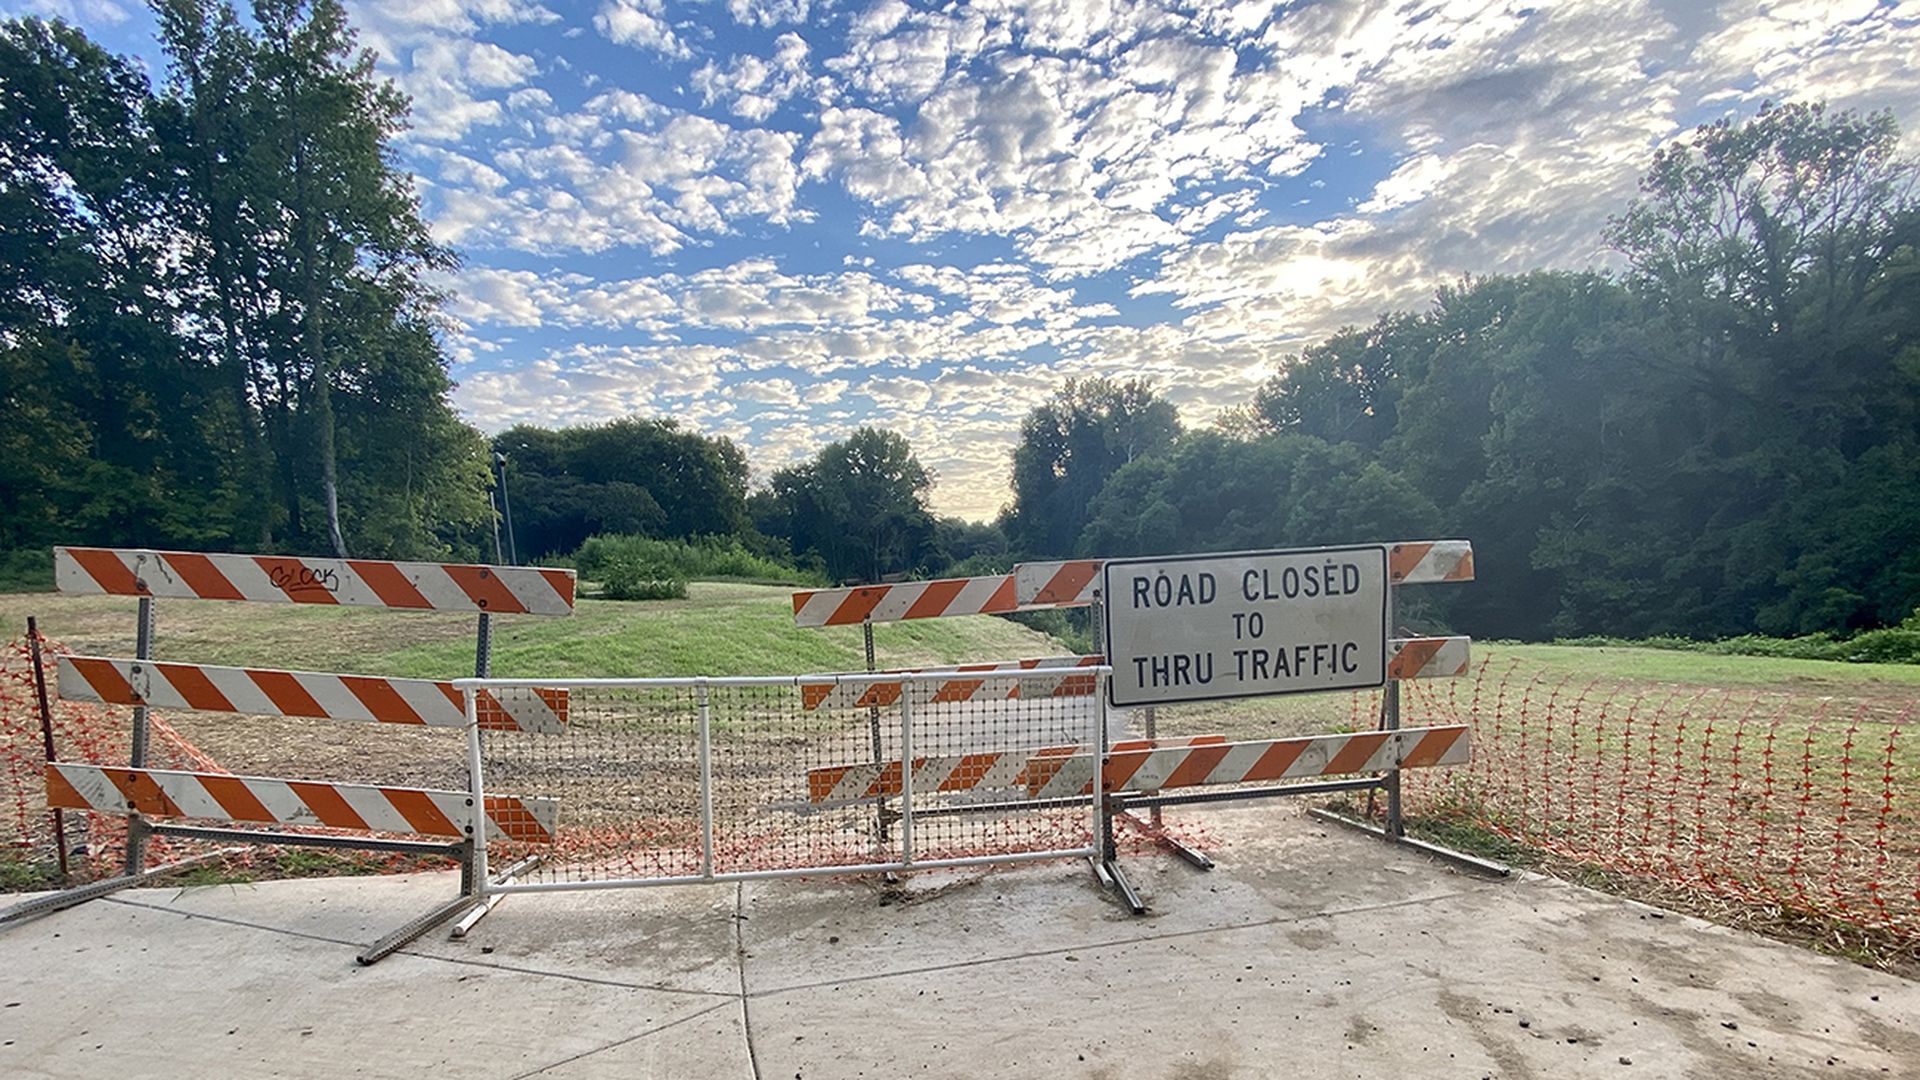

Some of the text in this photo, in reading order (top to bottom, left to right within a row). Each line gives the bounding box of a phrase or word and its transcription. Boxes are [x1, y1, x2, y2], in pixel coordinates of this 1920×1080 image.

[1133, 563, 1361, 609] ROAD CLOSED
[1231, 611, 1265, 640] TO
[1132, 641, 1359, 689] THRU TRAFFIC
